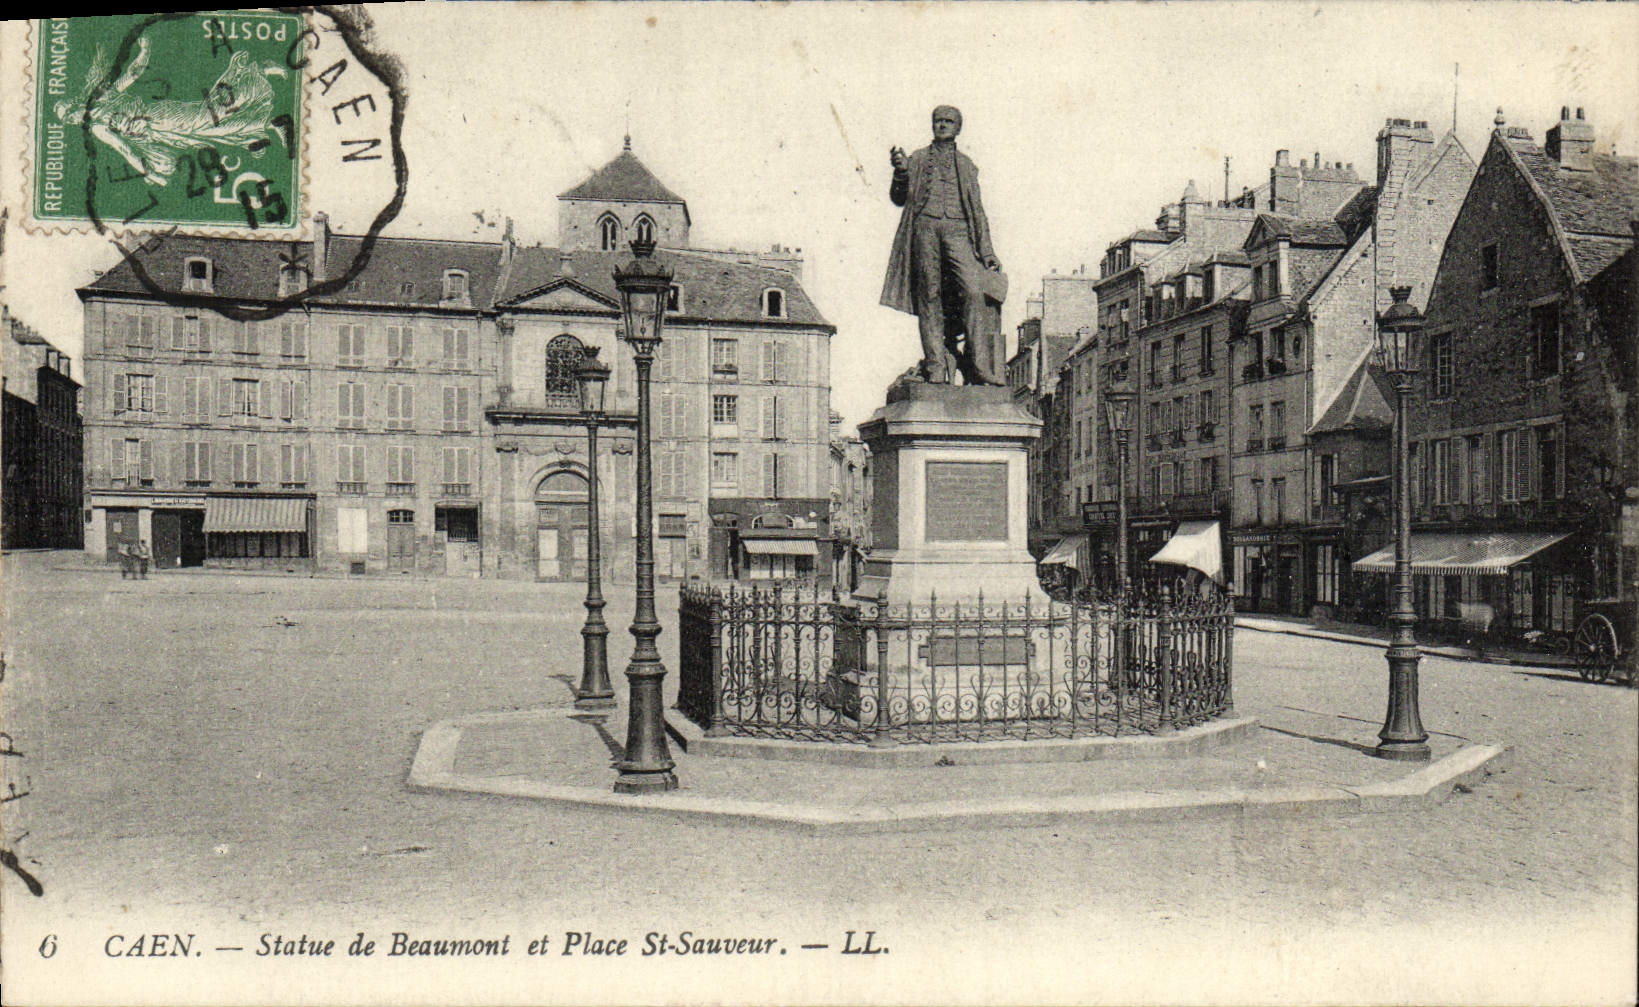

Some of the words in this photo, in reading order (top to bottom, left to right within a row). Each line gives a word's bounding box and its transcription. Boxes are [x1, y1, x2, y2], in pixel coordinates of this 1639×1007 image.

[49, 17, 69, 95] FRANÇAIS
[202, 19, 287, 42] POSTES
[286, 29, 383, 163] CAEN
[44, 122, 65, 212] REPUBLIQUE
